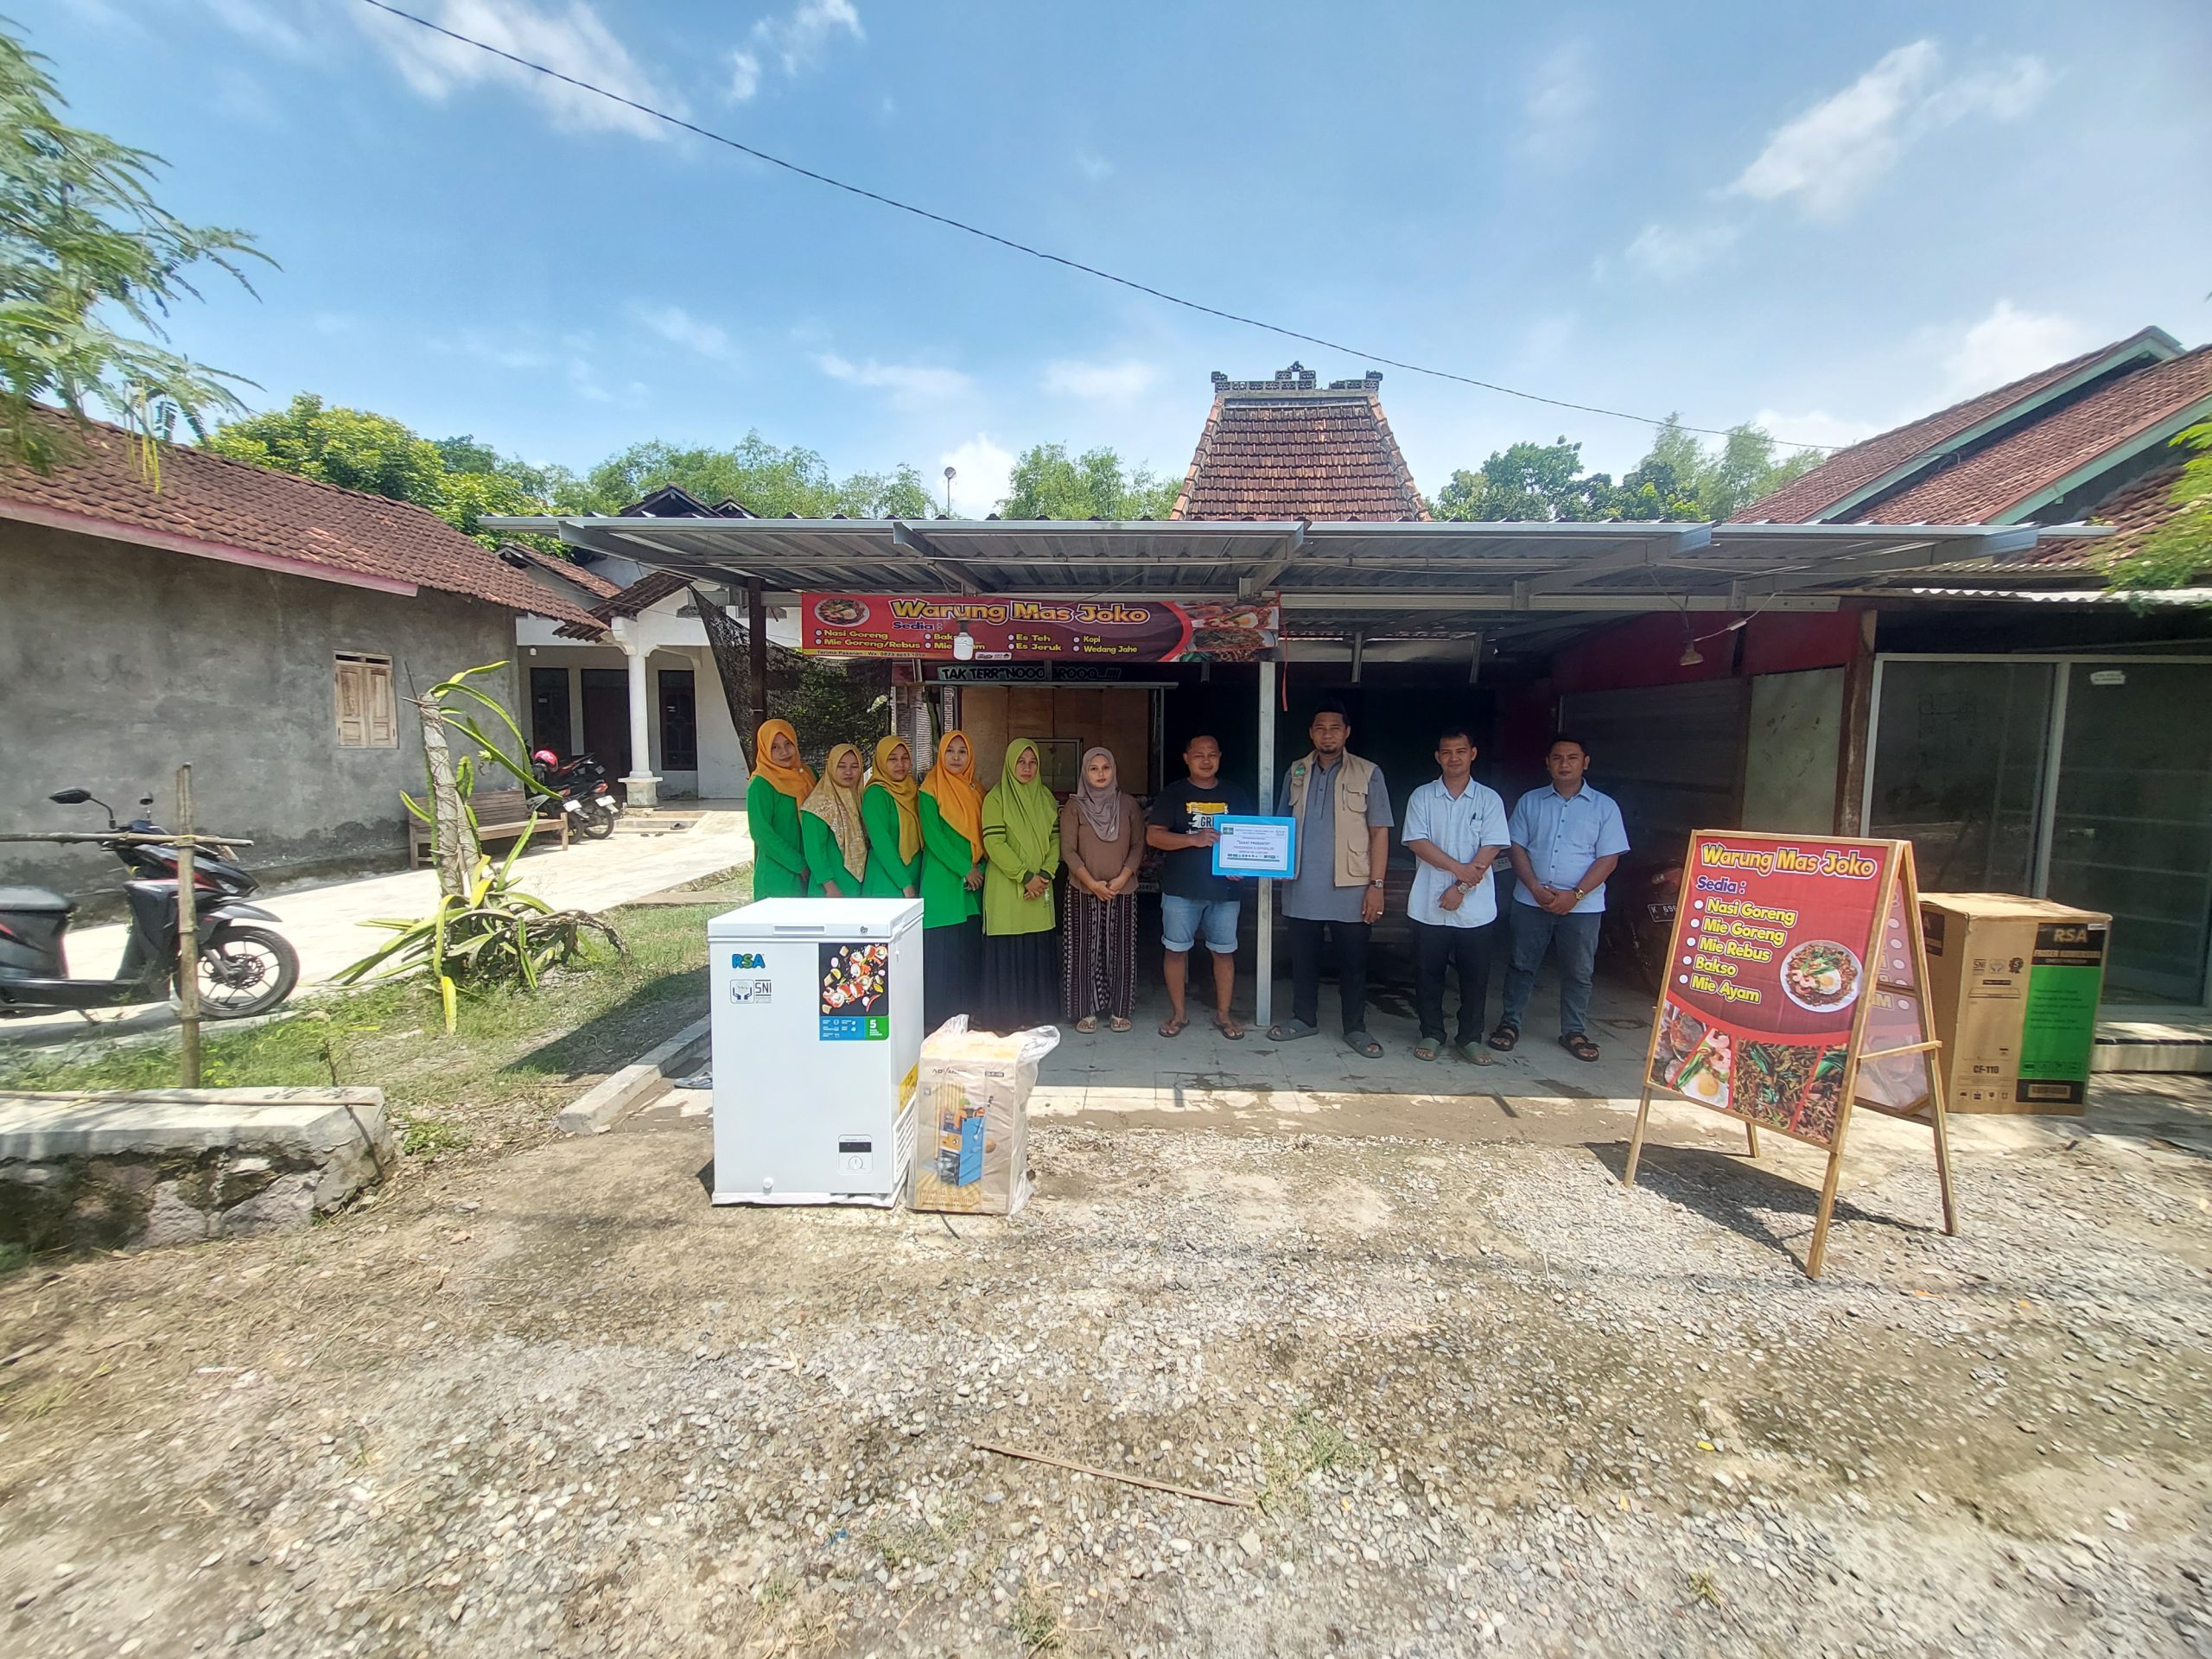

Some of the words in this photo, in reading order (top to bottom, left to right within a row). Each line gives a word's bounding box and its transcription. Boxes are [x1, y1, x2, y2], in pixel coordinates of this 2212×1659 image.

[890, 599, 1008, 625] Warung
[1012, 601, 1073, 622] Mas
[1076, 603, 1150, 624] Joko
[892, 621, 934, 631] Sedia
[849, 630, 889, 640] Goreng
[1083, 635, 1101, 644] Kopi
[844, 639, 921, 649] Goreng/Rebus
[1031, 643, 1062, 652] Jeruk
[1084, 645, 1116, 654] Wedang
[942, 668, 967, 680] TAK
[1700, 842, 1775, 875] Warung
[1776, 848, 1821, 874] Mas
[1820, 849, 1877, 879] Joko
[1695, 876, 1738, 893] Sedia
[1707, 898, 1739, 917] Nasi
[1740, 902, 1797, 926] Goreng
[1702, 918, 1729, 936] Mie
[1730, 921, 1786, 947] Goreng
[2053, 928, 2088, 943] RSA
[1698, 937, 1725, 955] Mie
[1726, 942, 1772, 963] Rebus
[732, 953, 766, 969] RSA
[1694, 956, 1738, 977] Bakso
[1973, 960, 1986, 969] SNI
[754, 982, 772, 994] SNI
[1691, 975, 1717, 994] Mie
[1718, 983, 1761, 1005] Ayam
[869, 1020, 877, 1029] 5
[1974, 1065, 1999, 1074] CF-110
